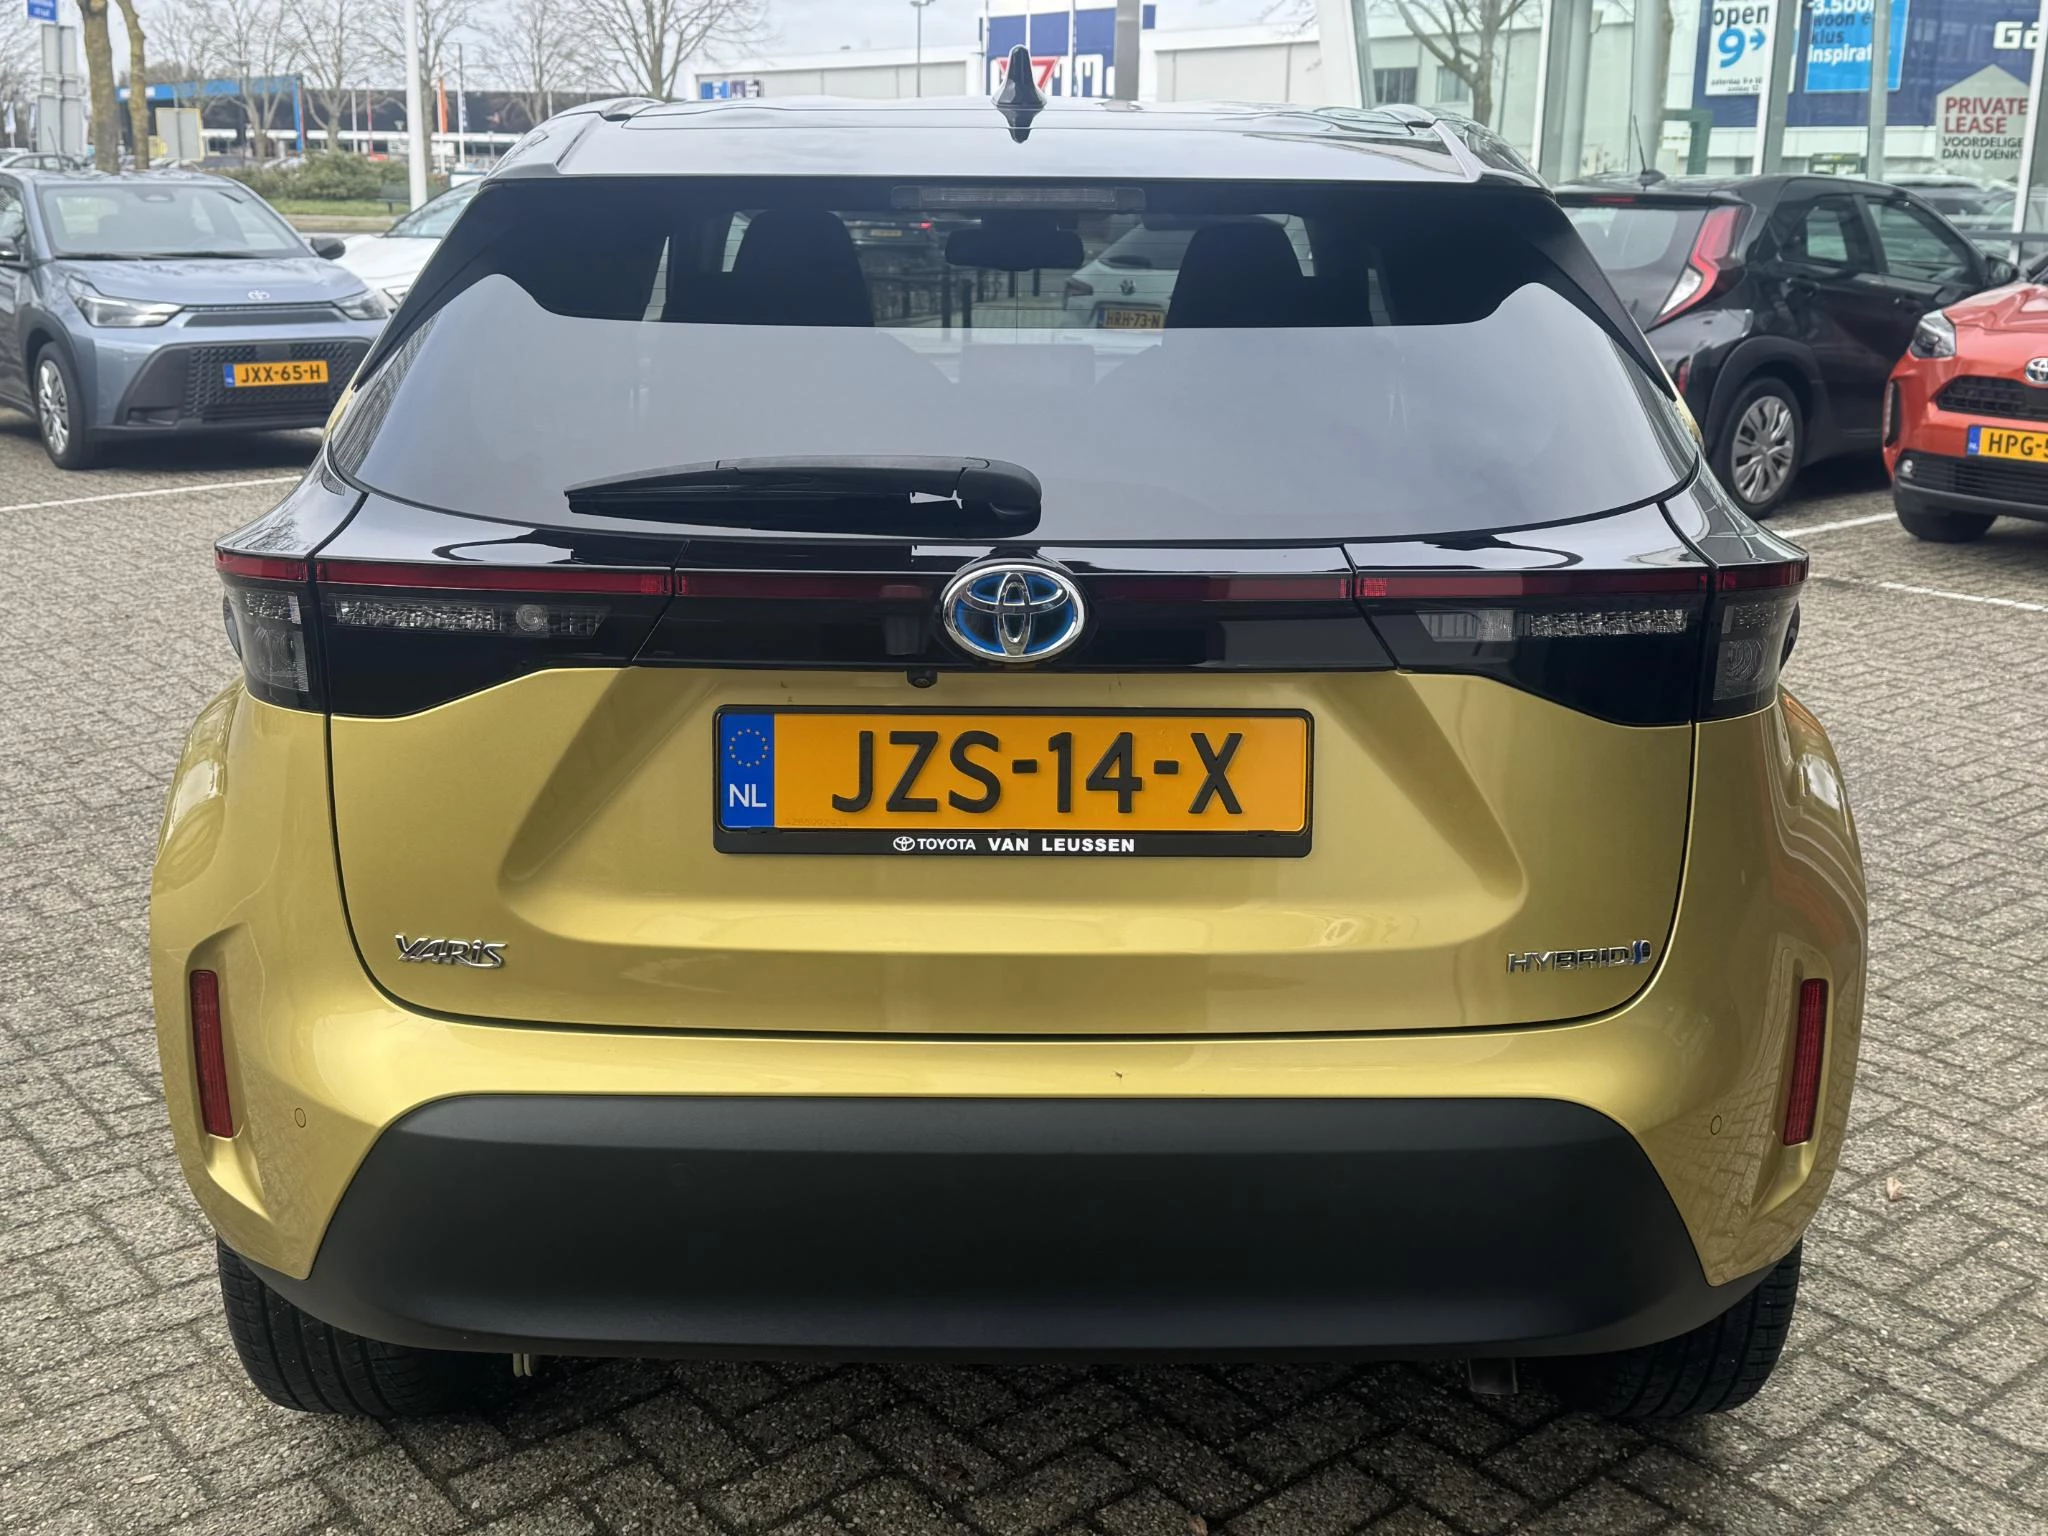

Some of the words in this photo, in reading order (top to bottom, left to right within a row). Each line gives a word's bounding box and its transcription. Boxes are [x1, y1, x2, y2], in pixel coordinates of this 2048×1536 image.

[1713, 6, 1769, 29] open
[1862, 13, 1872, 25] e
[1718, 28, 1745, 68] 9
[1808, 43, 1872, 66] inspirat
[1945, 97, 2028, 115] PRIVATE
[1944, 117, 2007, 134] LEASE
[1943, 136, 2024, 149] VOORDELIGE
[1942, 149, 1969, 160] DAN
[1972, 149, 1982, 160] U
[1984, 149, 2021, 160] DENK
[241, 364, 321, 383] JXX-65-H
[832, 729, 1243, 815] JZS-14-X
[729, 783, 767, 809] NL
[917, 838, 977, 852] TOYOTA
[988, 838, 1029, 852] VAN
[1042, 838, 1135, 853] LEUSSEN
[1506, 946, 1629, 973] HYBRID
